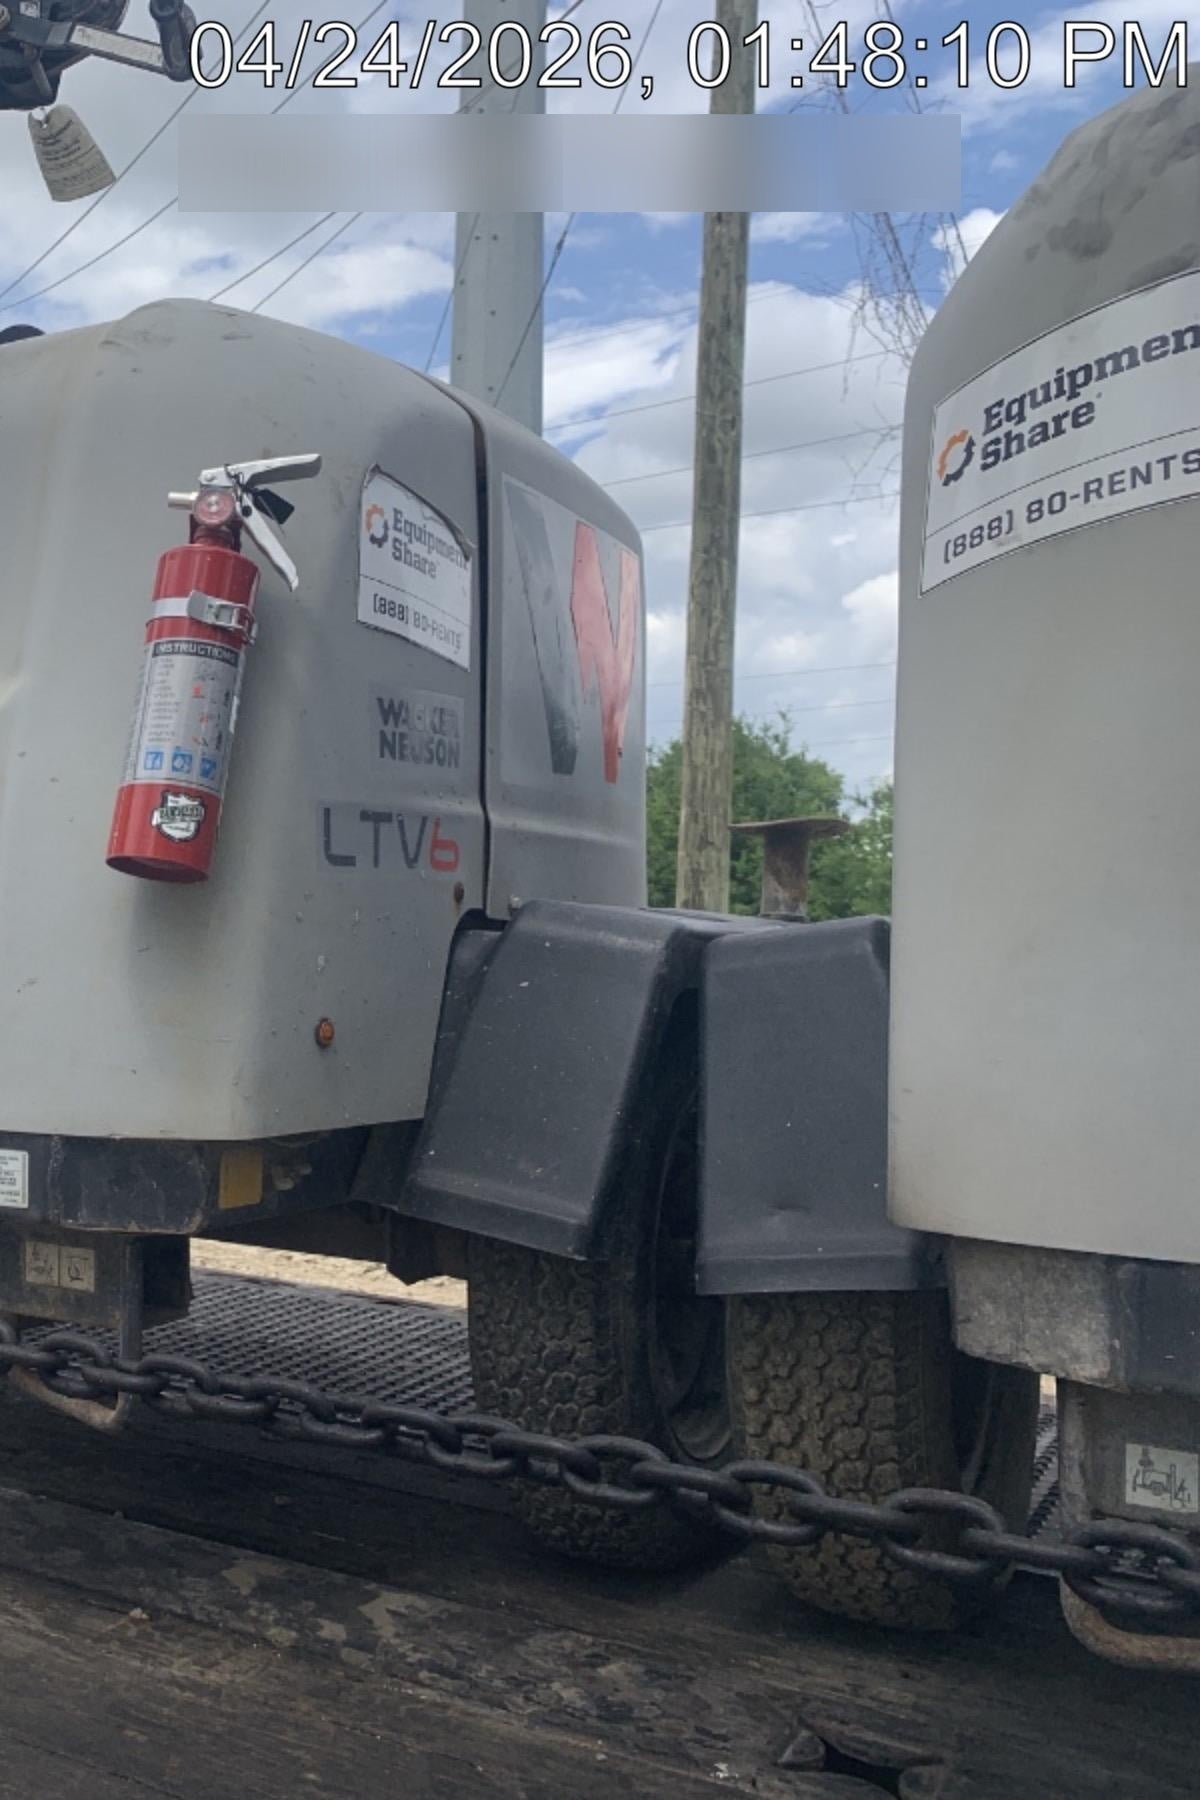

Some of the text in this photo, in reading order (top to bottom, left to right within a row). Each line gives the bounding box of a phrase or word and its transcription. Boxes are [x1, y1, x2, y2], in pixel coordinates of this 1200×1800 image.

[979, 400, 1096, 473] Share
[943, 447, 1200, 565] (888) 80-RENTS
[391, 537, 438, 580] Share
[392, 507, 469, 572] Equipment
[154, 641, 239, 667] INSTRUCTIONS
[323, 807, 460, 872] LTV6
